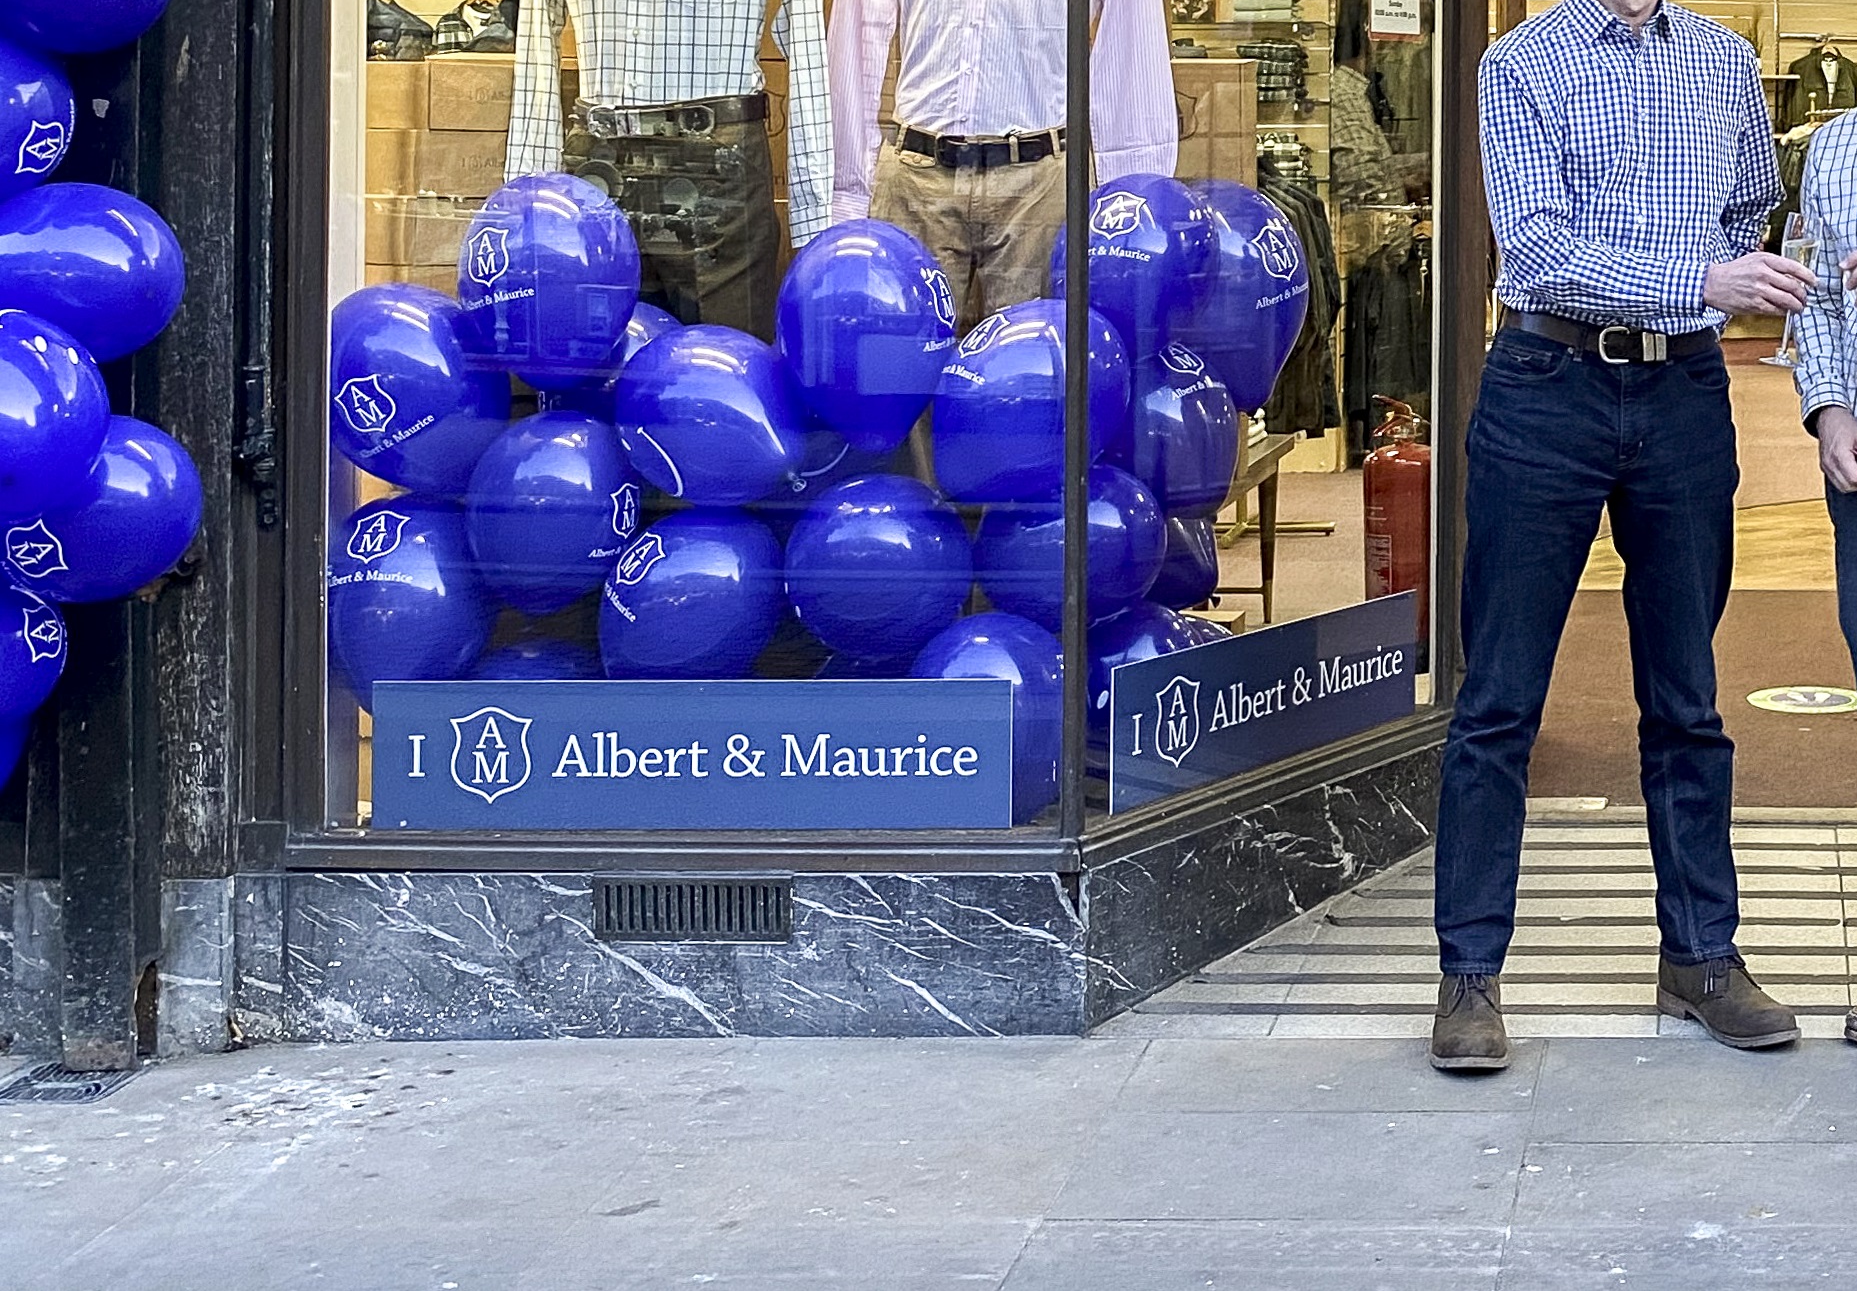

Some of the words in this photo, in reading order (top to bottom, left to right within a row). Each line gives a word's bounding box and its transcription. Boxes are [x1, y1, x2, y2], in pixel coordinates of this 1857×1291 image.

[1108, 245, 1151, 262] Maurice
[484, 292, 493, 305] &
[494, 286, 535, 304] Maurice
[1256, 293, 1284, 310] Albert
[384, 436, 393, 449] &
[393, 413, 434, 443] Maurice
[353, 571, 363, 582] &
[363, 569, 413, 585] Maurice
[1132, 713, 1143, 756] I
[1208, 680, 1287, 734] Albert
[1292, 666, 1313, 707] &
[1318, 647, 1404, 699] Maurice
[407, 734, 427, 779] I
[551, 731, 710, 779] Albert
[722, 734, 767, 778] &
[780, 733, 979, 778] Maurice
